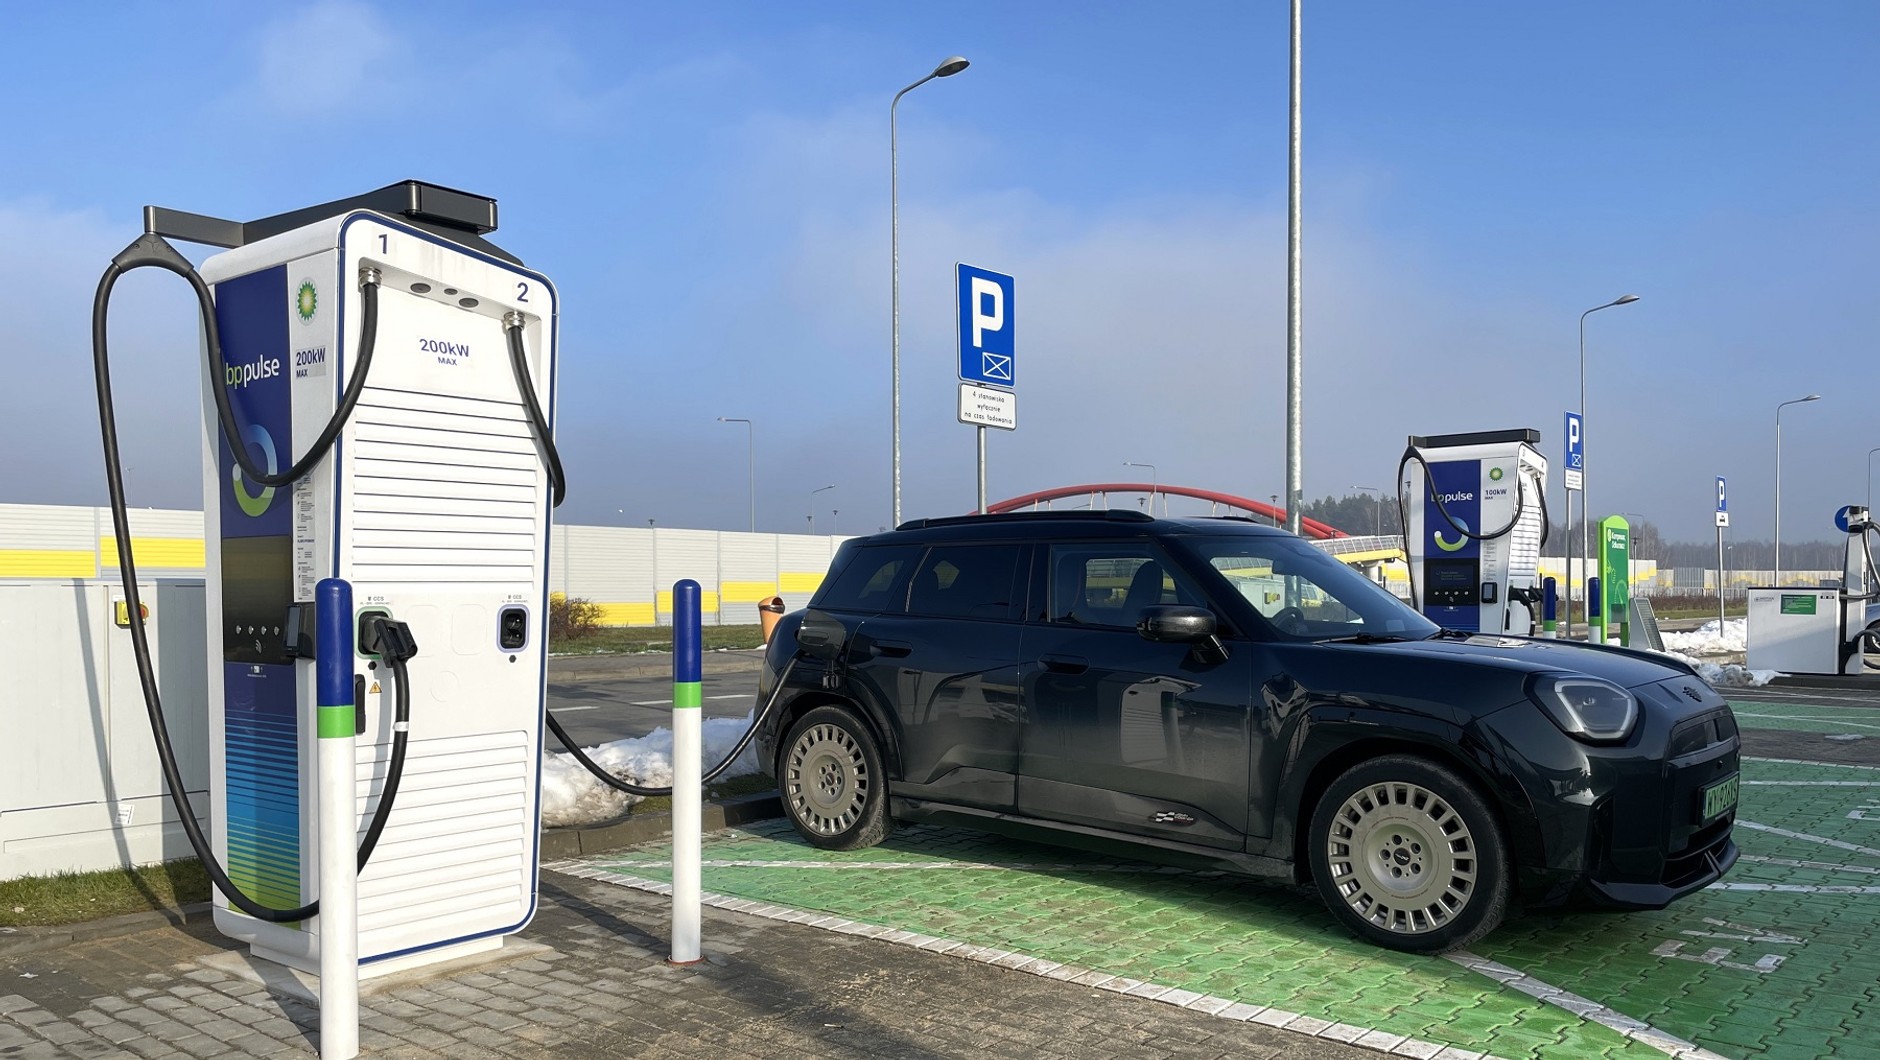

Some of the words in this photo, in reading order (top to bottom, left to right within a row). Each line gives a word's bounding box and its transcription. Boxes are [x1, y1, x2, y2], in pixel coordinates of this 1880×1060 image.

[379, 234, 388, 255] 1
[517, 282, 529, 303] 2
[971, 276, 1004, 348] P
[296, 348, 327, 367] 200kW
[419, 338, 470, 358] 200kW
[437, 355, 458, 366] MAX
[296, 369, 308, 379] MAX
[978, 393, 1005, 403] stanowiska
[1569, 417, 1579, 452] P
[1718, 480, 1725, 507] P
